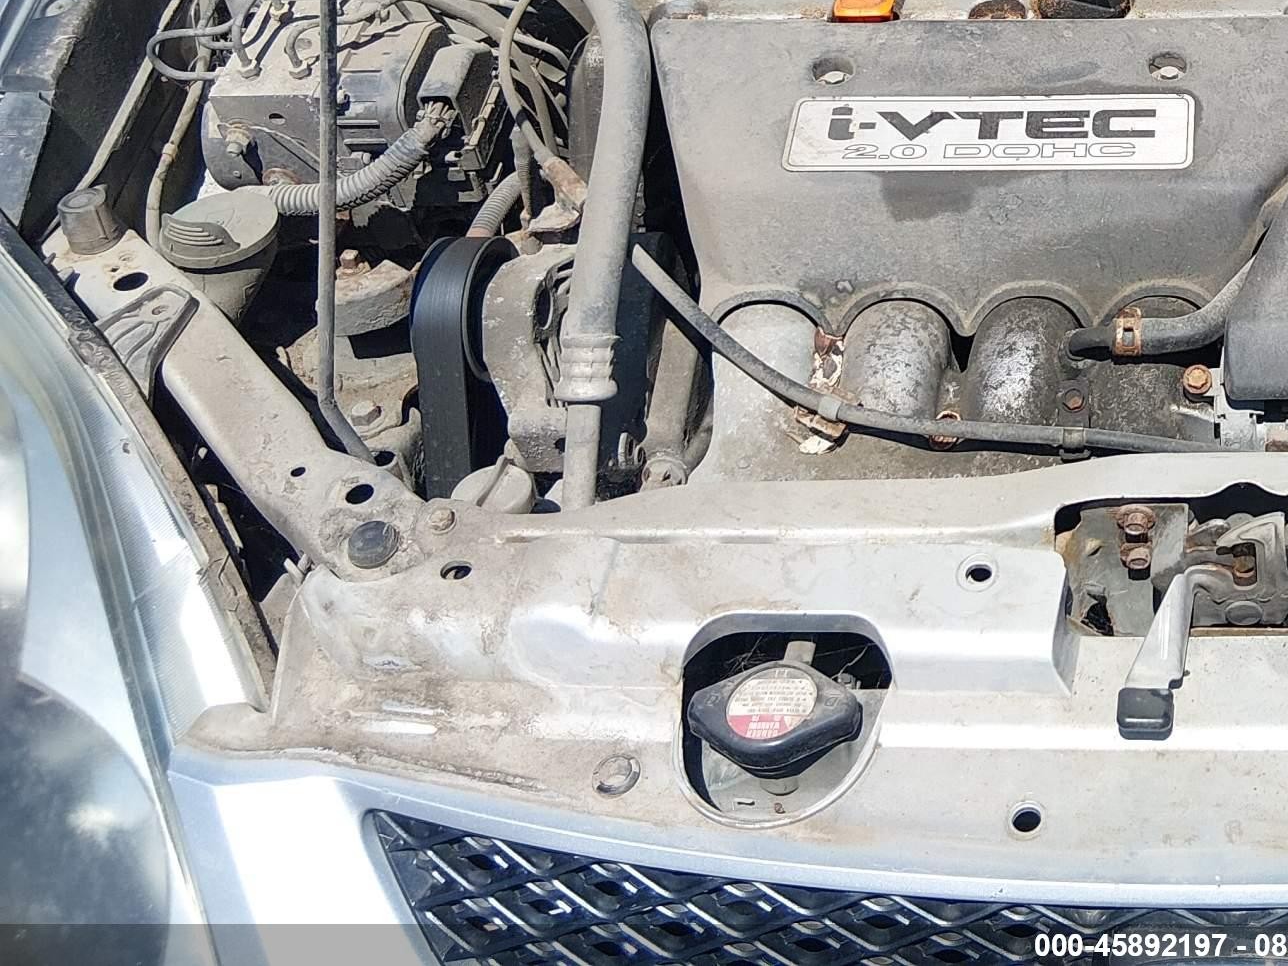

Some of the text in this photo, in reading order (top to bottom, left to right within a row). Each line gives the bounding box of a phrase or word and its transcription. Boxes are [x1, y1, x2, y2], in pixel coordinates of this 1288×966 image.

[828, 105, 1156, 140] i-VTEC
[842, 143, 1136, 159] 2.0 DOHC
